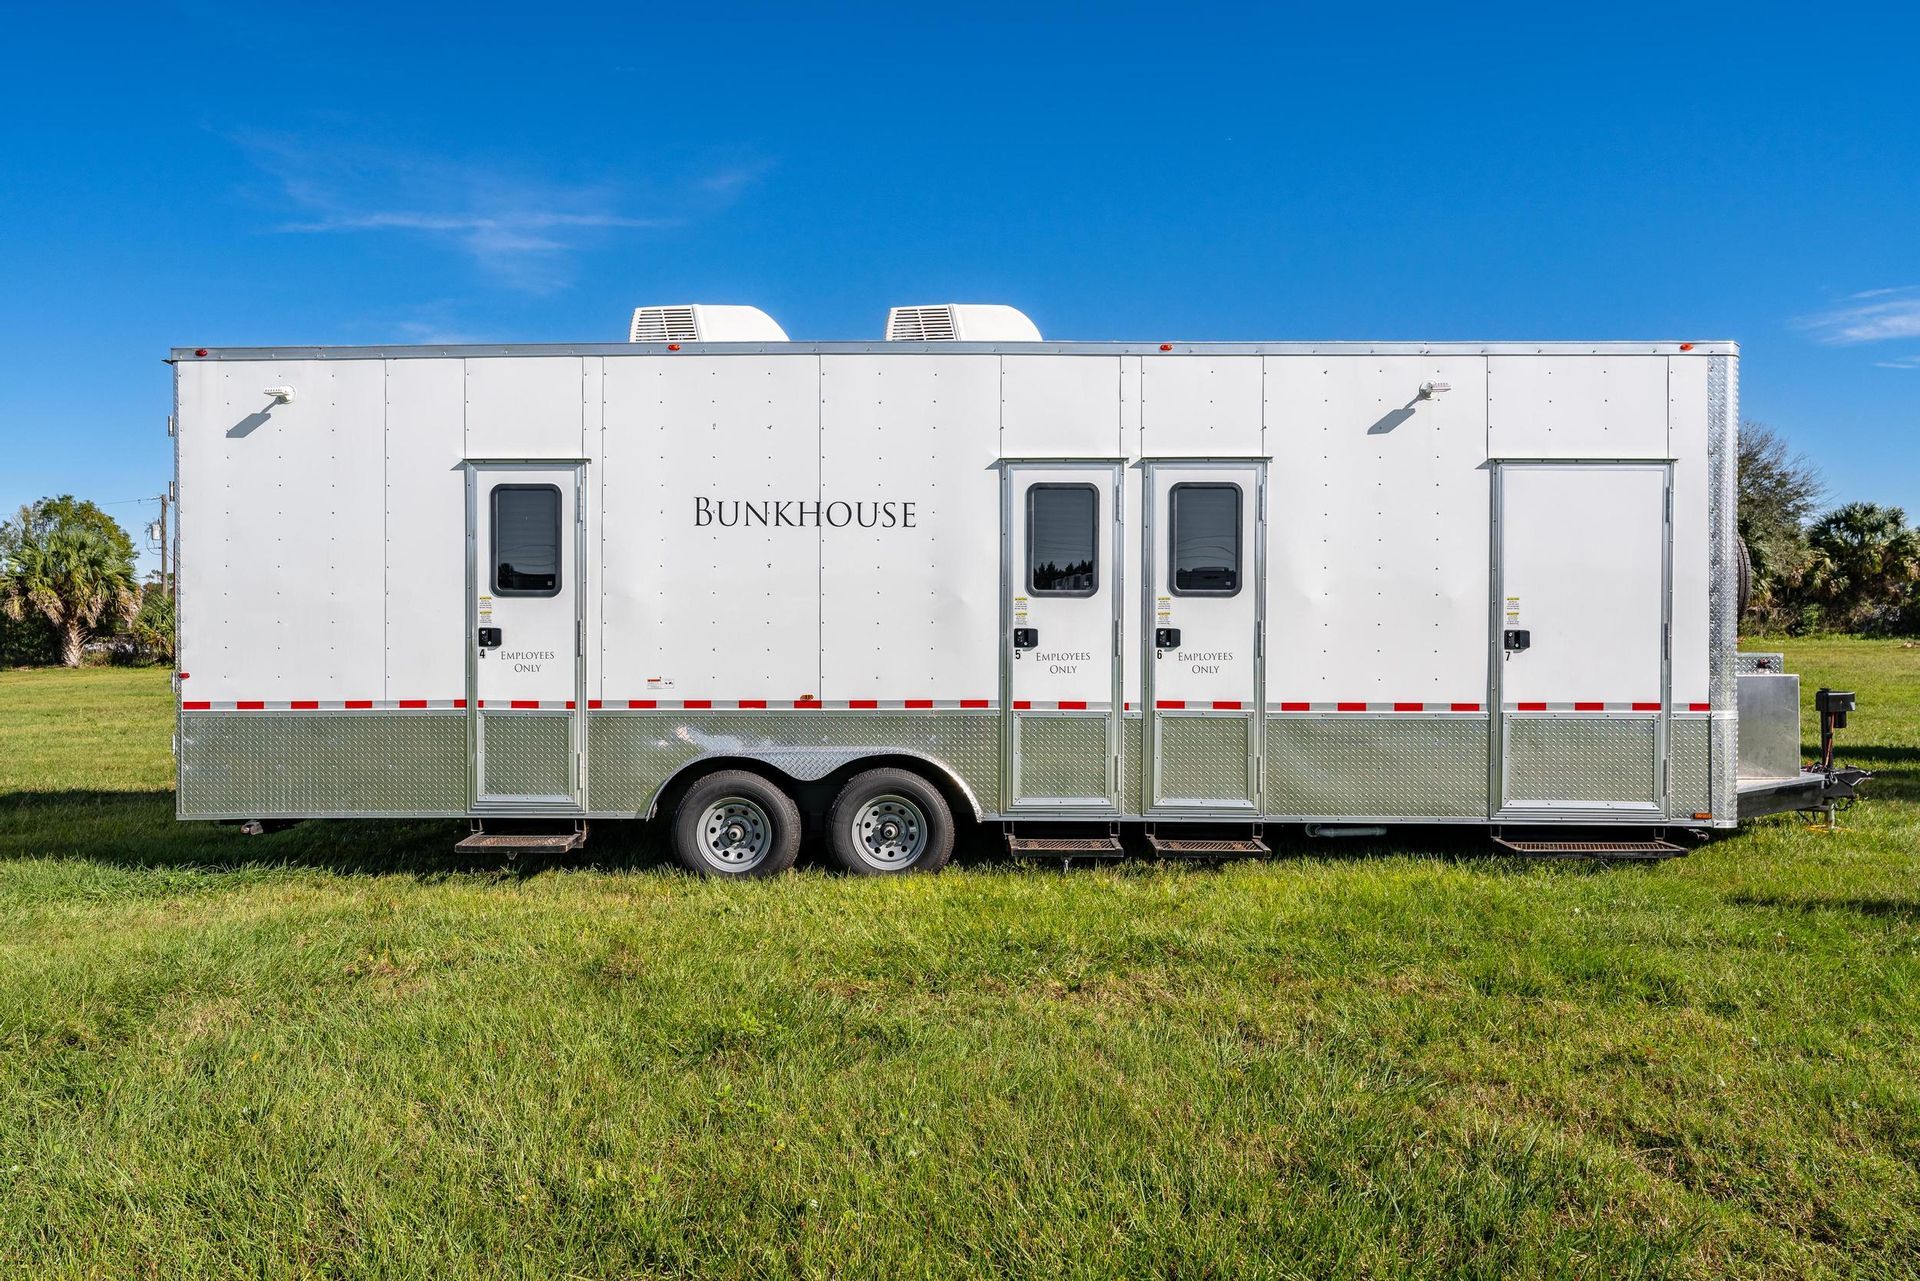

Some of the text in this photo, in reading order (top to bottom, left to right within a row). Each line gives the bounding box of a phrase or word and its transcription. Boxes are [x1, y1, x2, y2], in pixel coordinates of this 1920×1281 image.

[694, 496, 917, 528] BUNKHOUSE
[479, 649, 486, 659] 4
[501, 651, 555, 660] EMPLOYEES
[1015, 649, 1021, 660] 5
[1036, 652, 1091, 661] EMPLOYEES
[1156, 649, 1163, 660] 6
[1178, 652, 1233, 661] EMPLOYEES
[1505, 651, 1511, 661] 7
[514, 663, 542, 673] ONLY
[1049, 664, 1077, 674] ONLY
[1191, 664, 1220, 674] ONLY
